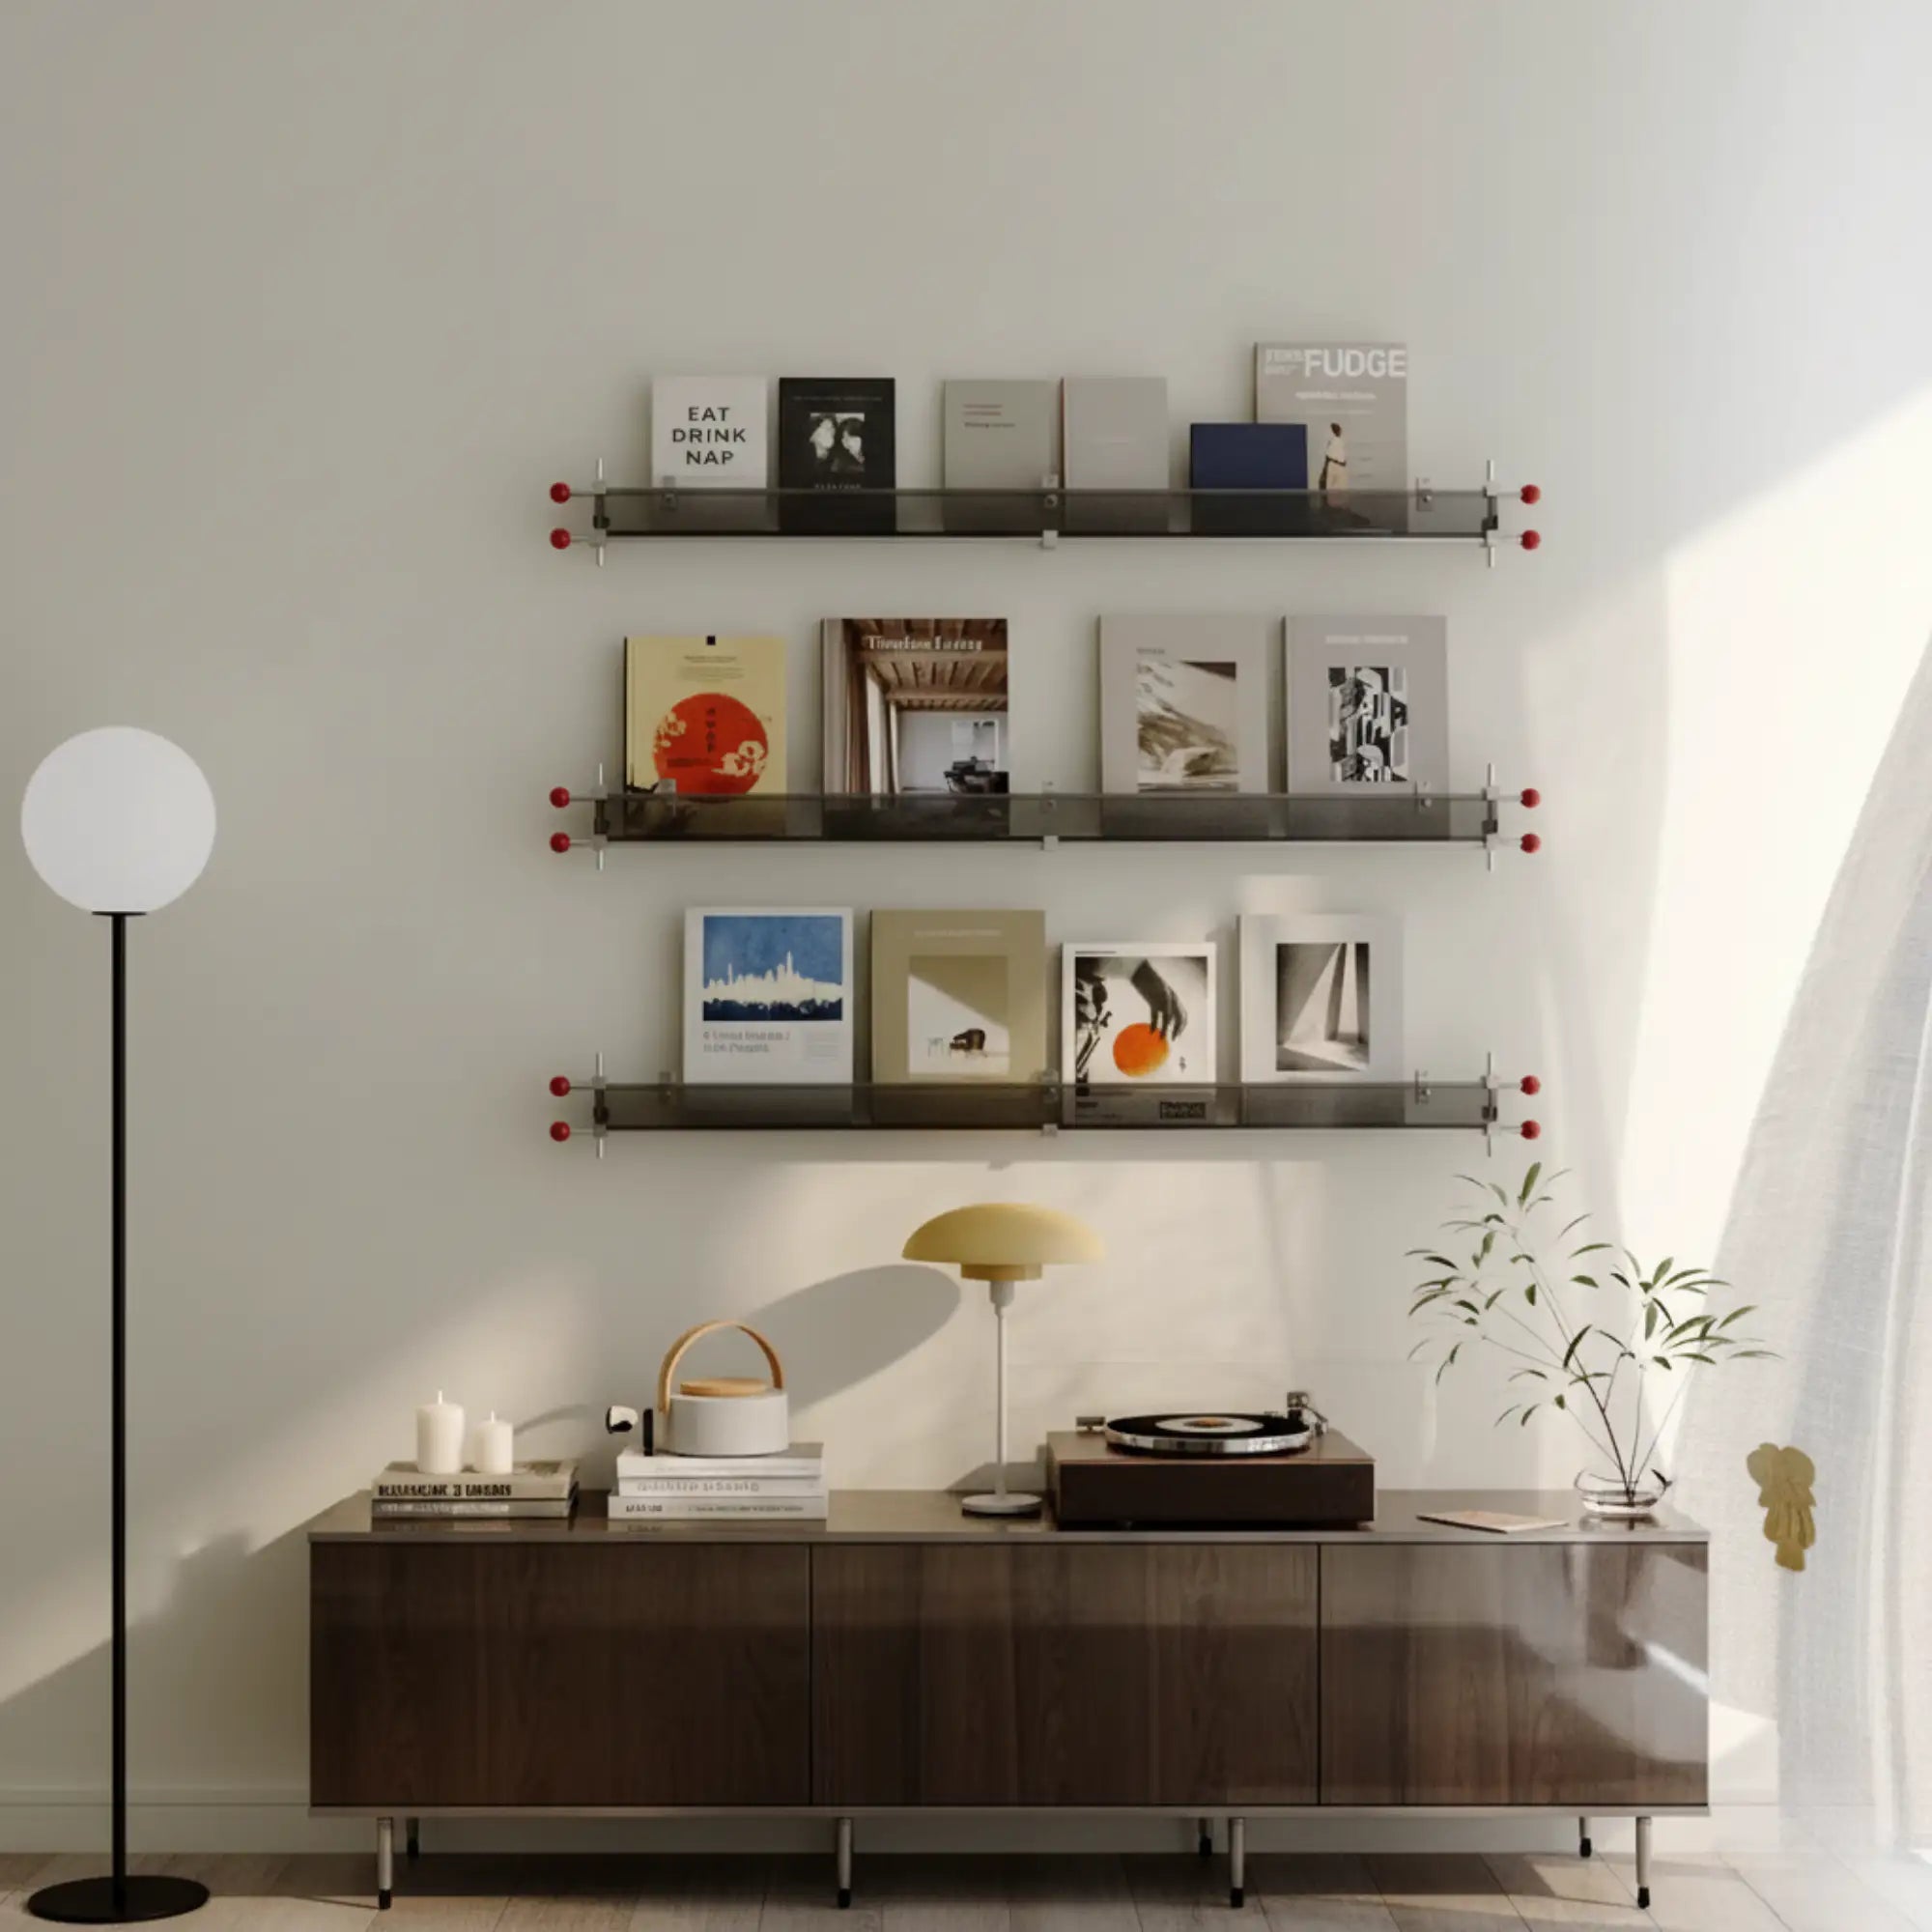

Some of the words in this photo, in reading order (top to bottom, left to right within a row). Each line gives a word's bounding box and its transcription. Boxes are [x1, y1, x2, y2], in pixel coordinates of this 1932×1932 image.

[1304, 349, 1406, 378] FUDGE
[688, 406, 730, 422] EAT
[671, 428, 747, 443] DRINK
[685, 450, 734, 466] NAP
